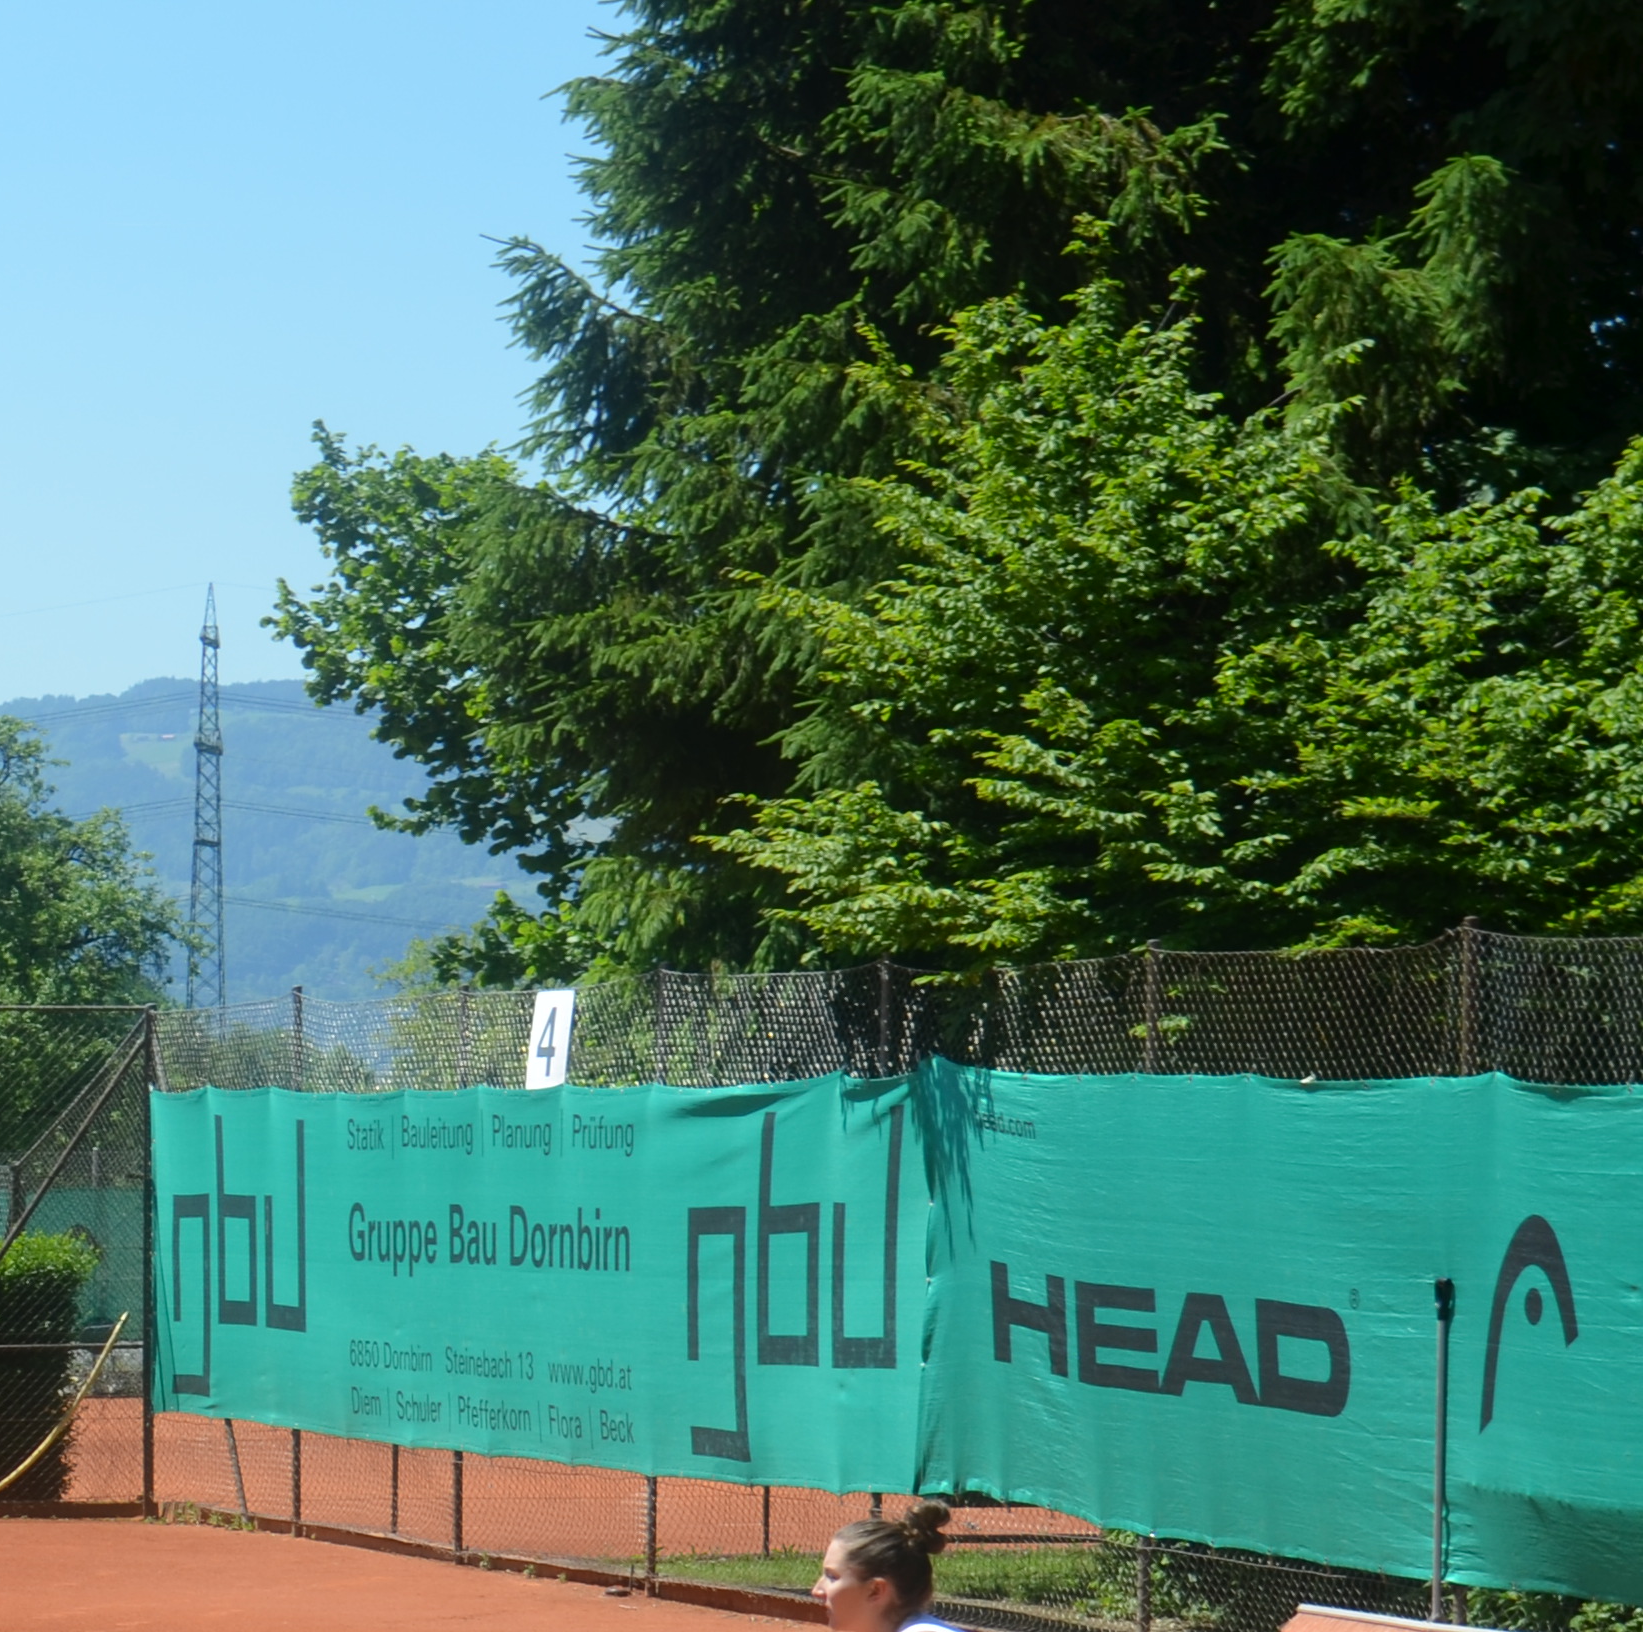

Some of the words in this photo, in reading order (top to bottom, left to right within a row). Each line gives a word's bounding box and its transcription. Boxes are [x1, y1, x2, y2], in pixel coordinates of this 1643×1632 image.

[536, 1006, 558, 1077] 4
[347, 1118, 385, 1150] Statik
[401, 1114, 473, 1155] Bauleitung
[492, 1114, 552, 1156] Planung
[572, 1114, 634, 1157] Prüfung
[348, 1202, 438, 1277] Gruppe
[449, 1204, 497, 1265] Bau
[509, 1205, 630, 1272] Dornbirn
[349, 1339, 380, 1369] 6850
[384, 1342, 432, 1372] Dornbirn
[445, 1346, 512, 1379] Steinebach
[518, 1351, 534, 1381] 13
[548, 1357, 632, 1393] www.gbd.at
[989, 1260, 1352, 1417] HEAD
[351, 1386, 381, 1416] Diem
[396, 1390, 442, 1422] Schuler
[458, 1395, 531, 1432] Pfefferkorn
[548, 1404, 582, 1439] Flora
[599, 1409, 635, 1444] Beck
